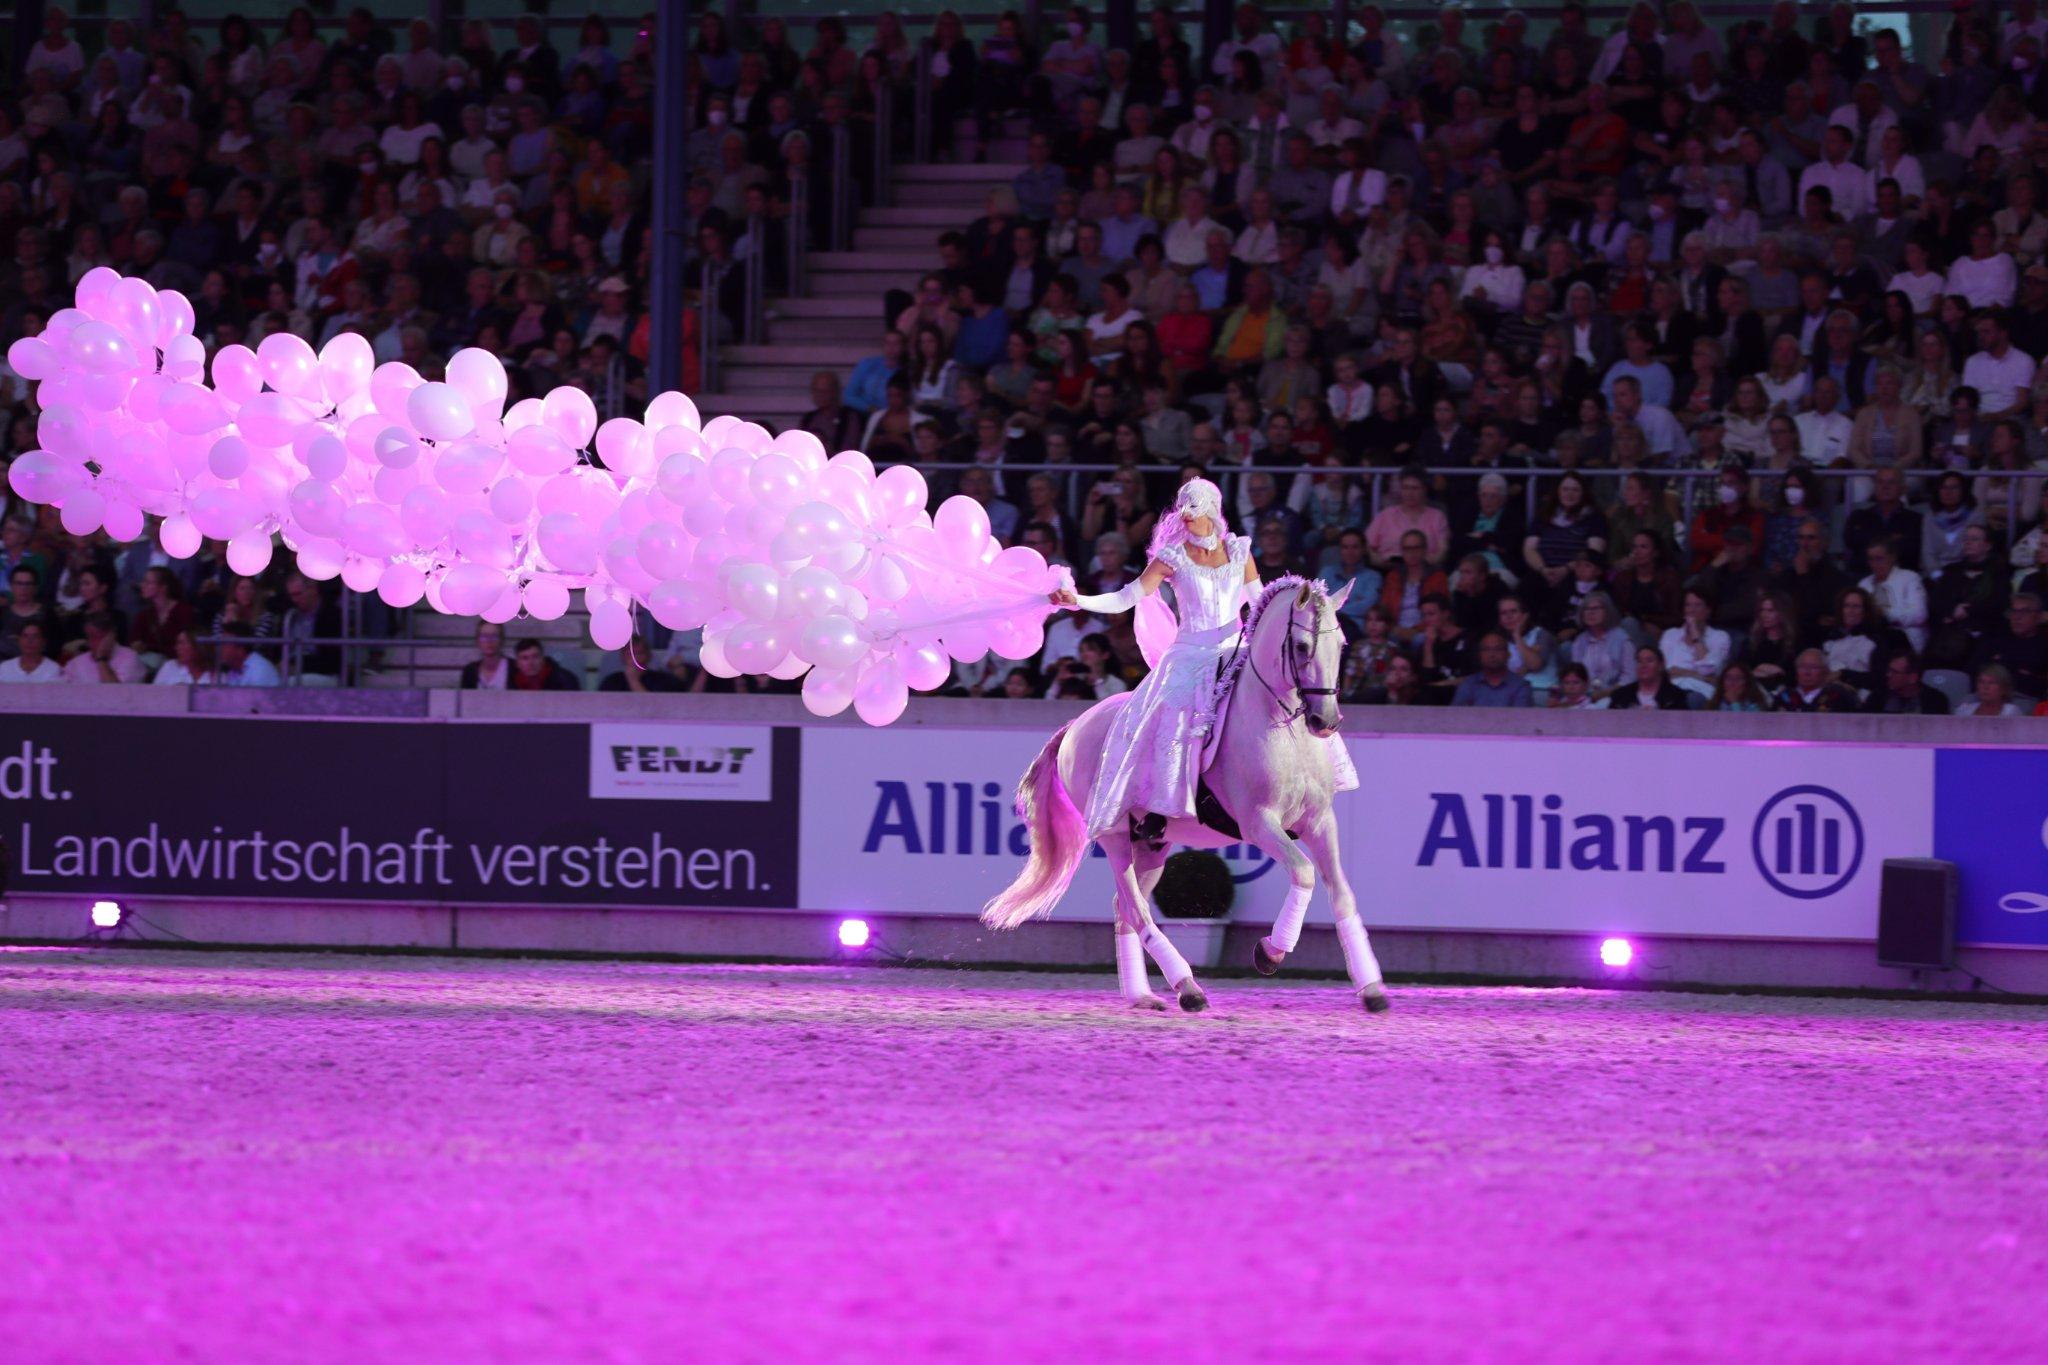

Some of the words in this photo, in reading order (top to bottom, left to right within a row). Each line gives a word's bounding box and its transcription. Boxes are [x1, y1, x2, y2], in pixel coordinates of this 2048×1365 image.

[610, 744, 755, 774] FENDT
[862, 780, 1107, 858] Alli
[1416, 792, 1727, 875] Allianz
[22, 822, 453, 885] Landwirtschaft
[469, 831, 771, 891] verstehen.
